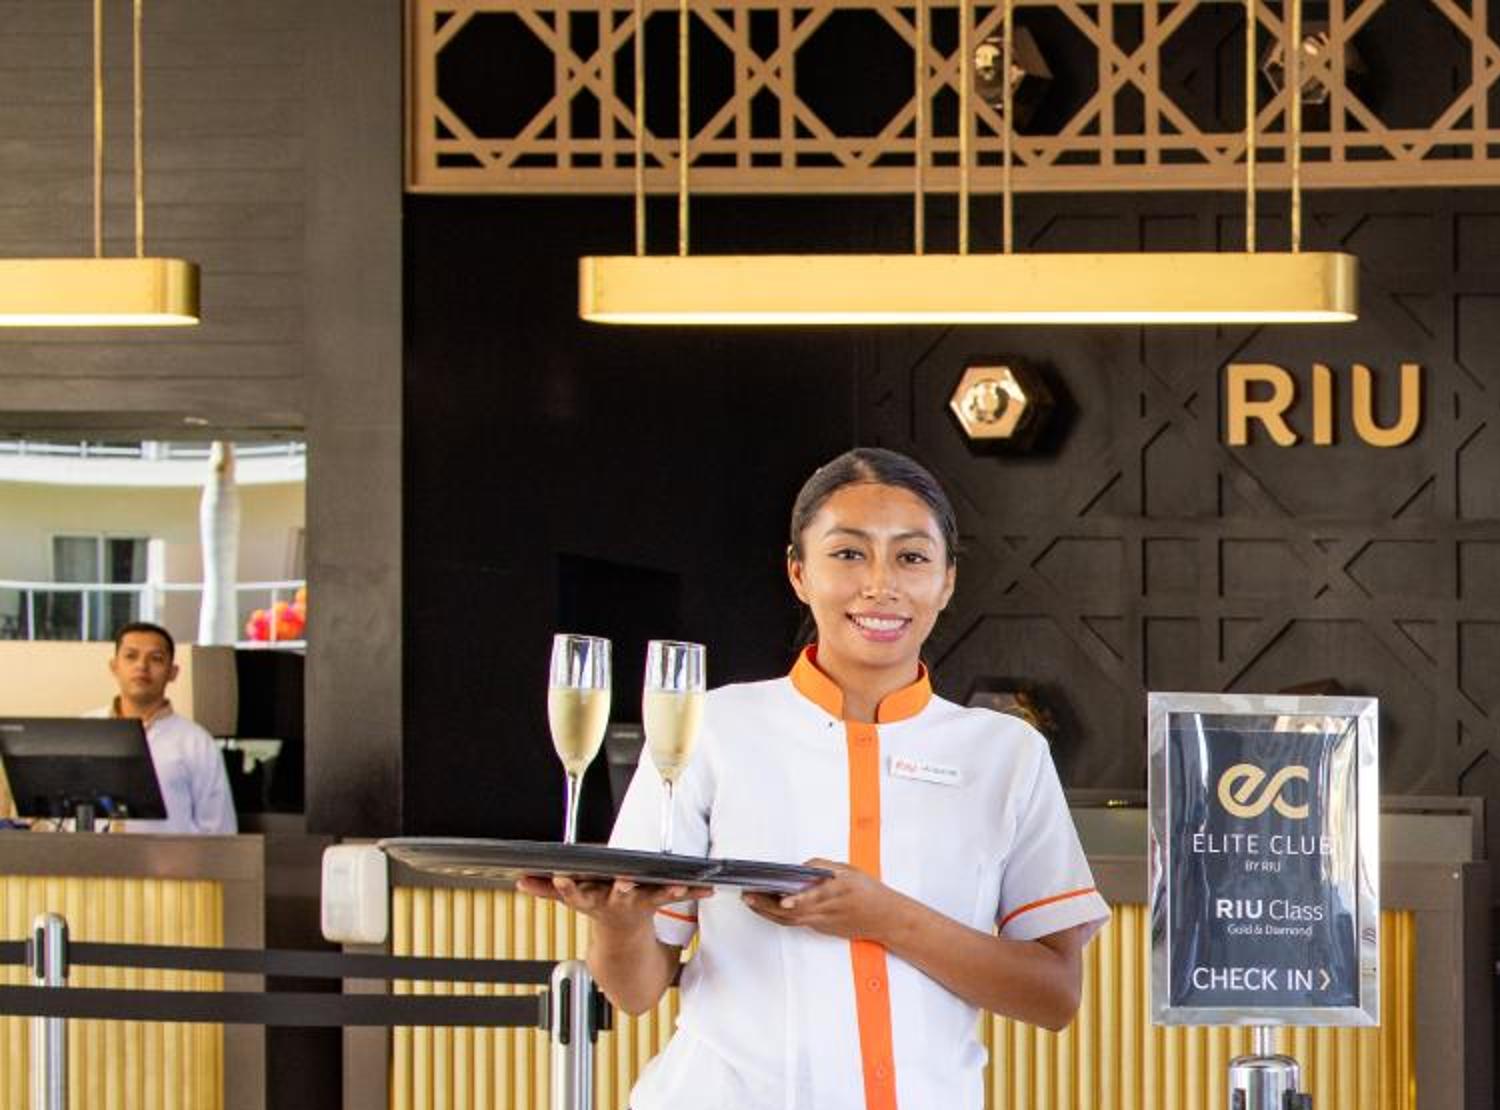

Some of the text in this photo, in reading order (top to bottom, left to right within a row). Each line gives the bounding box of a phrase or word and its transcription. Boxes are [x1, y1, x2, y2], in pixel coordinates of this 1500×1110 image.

[1227, 363, 1420, 448] RIU
[1193, 833, 1259, 854] ELITE
[1261, 861, 1281, 873] RIU
[1216, 899, 1324, 921] RIU Class
[1227, 924, 1313, 936] Gold & Diamond
[1192, 967, 1312, 991] CHECK IN
